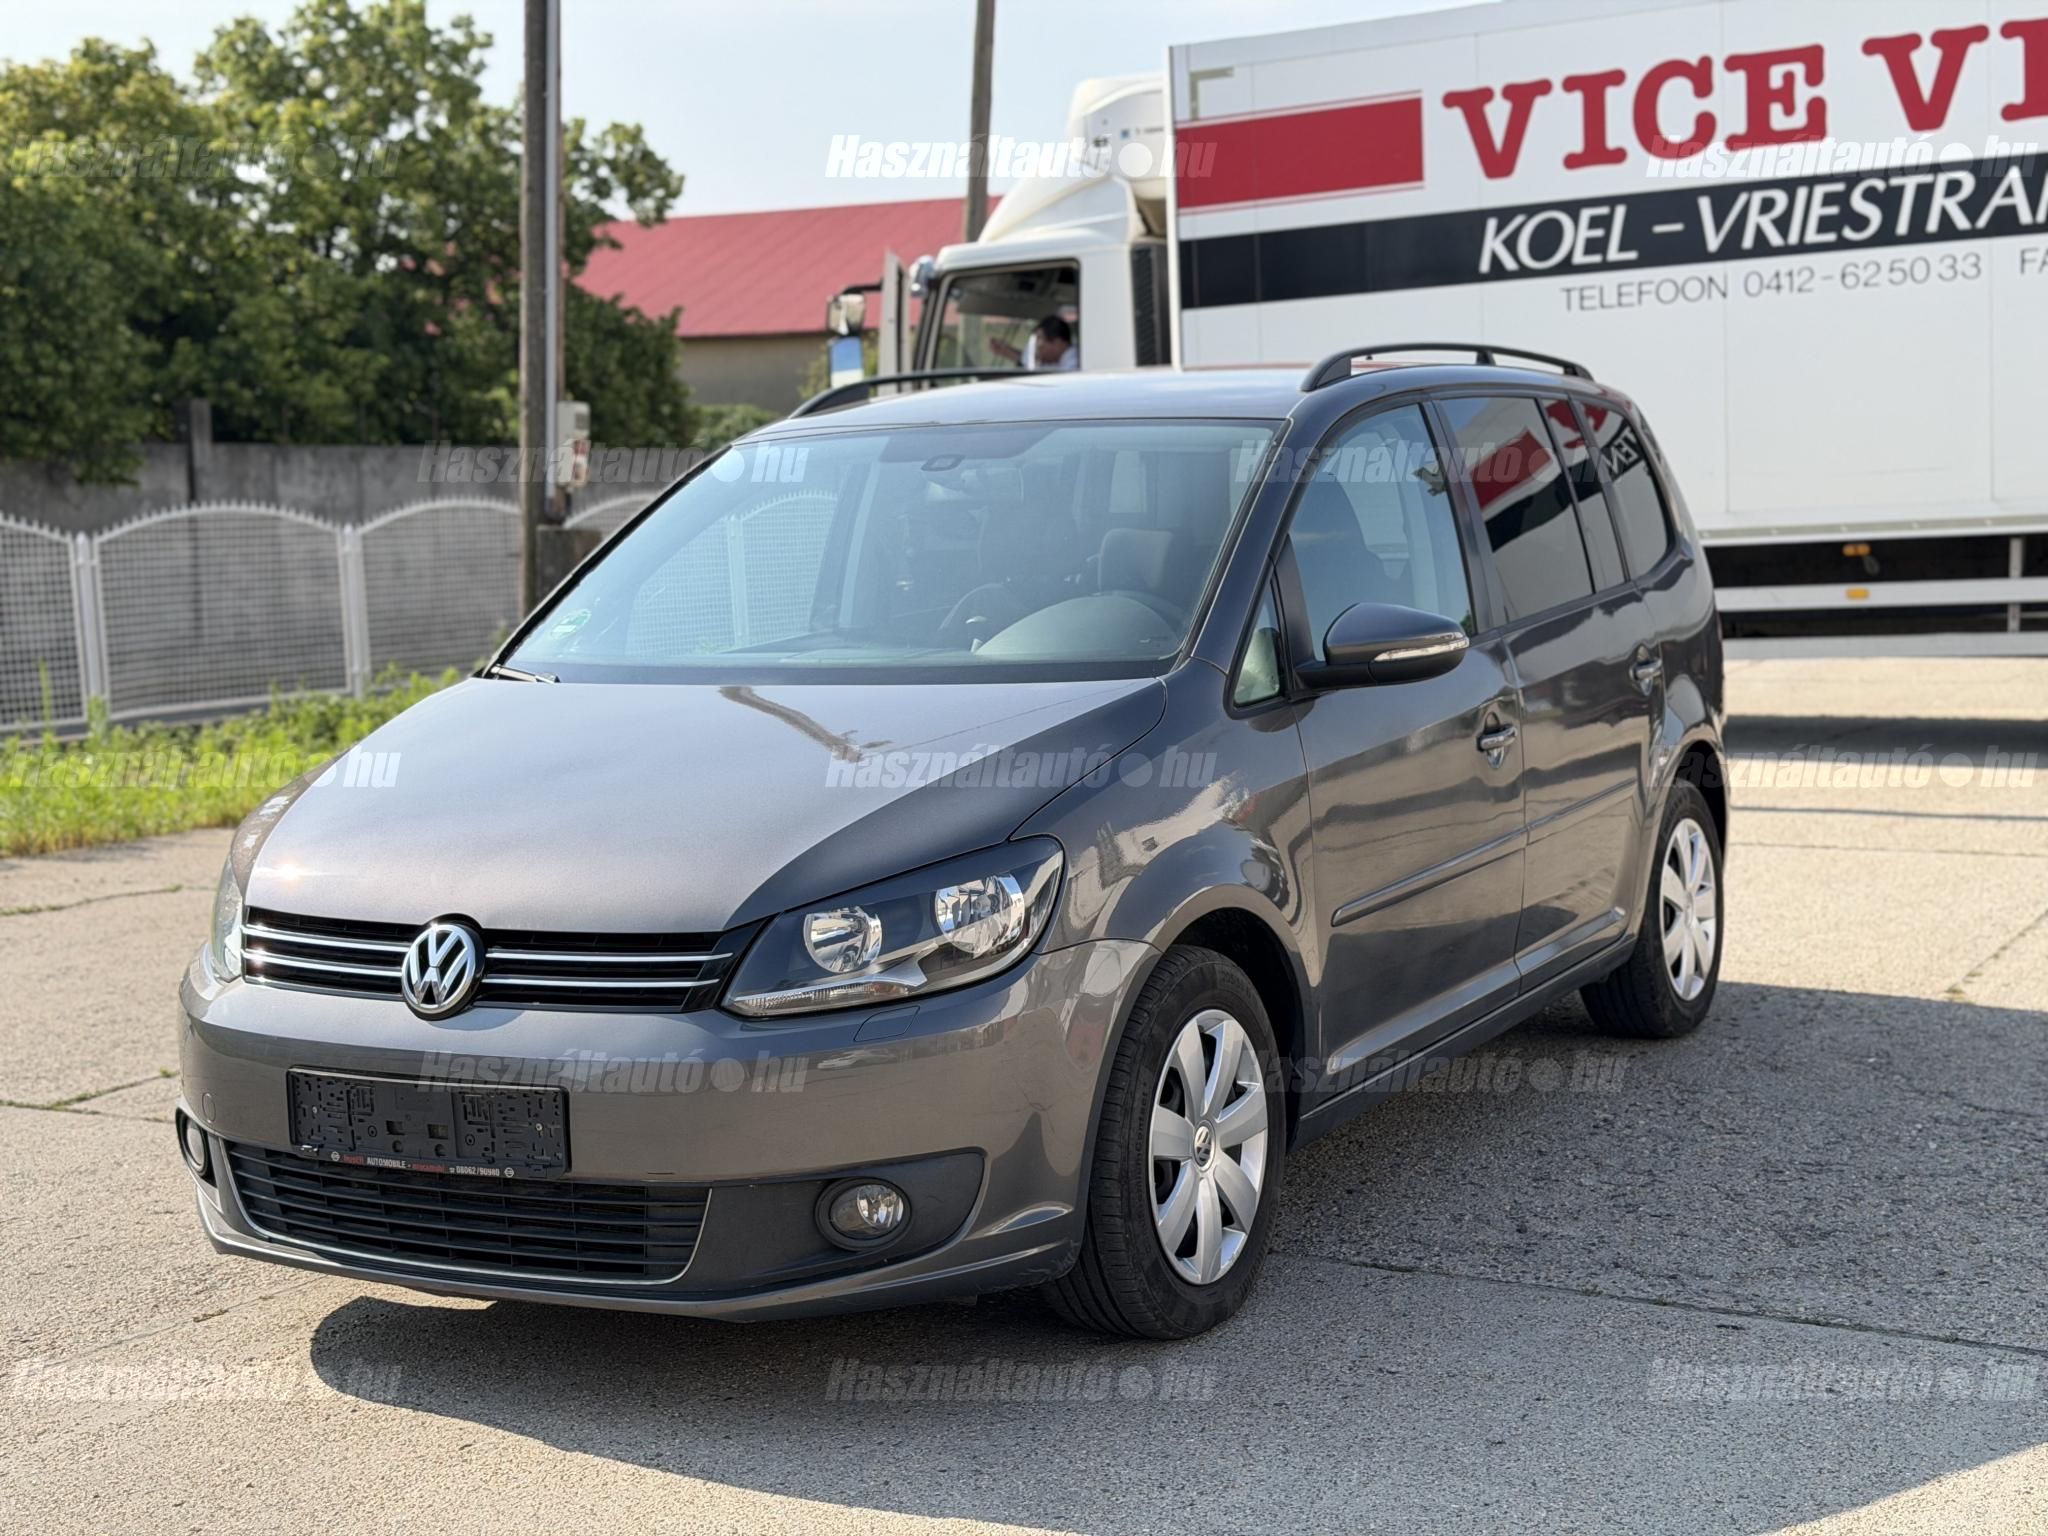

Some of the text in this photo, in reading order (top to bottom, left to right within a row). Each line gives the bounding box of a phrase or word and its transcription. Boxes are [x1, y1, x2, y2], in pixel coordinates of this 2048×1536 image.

[1442, 43, 1826, 180] VICE
[1479, 204, 1638, 274] KOEL
[1560, 274, 1728, 312] TELEFOON
[366, 1156, 407, 1169] AUTOMOBILE
